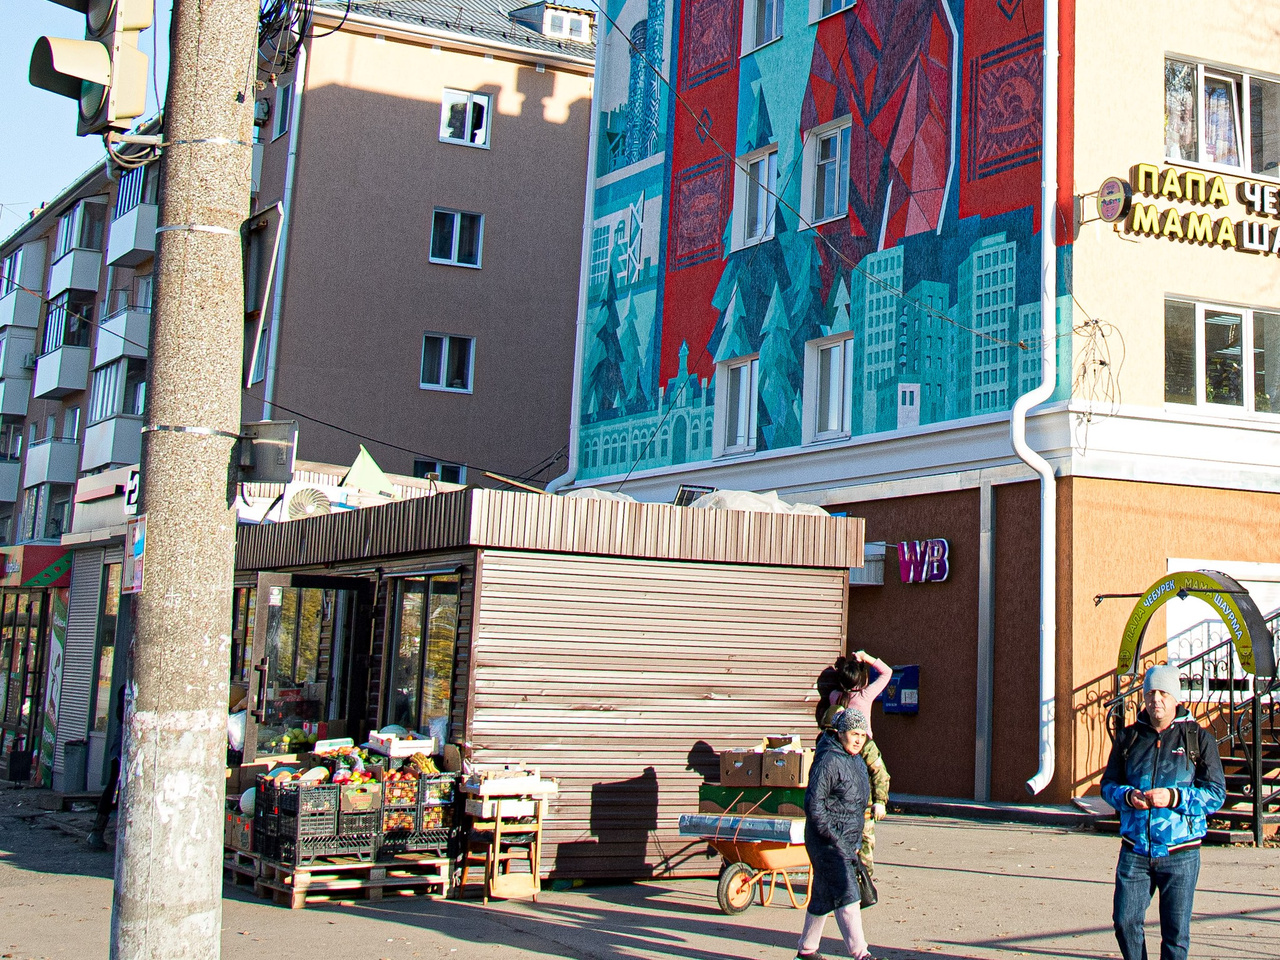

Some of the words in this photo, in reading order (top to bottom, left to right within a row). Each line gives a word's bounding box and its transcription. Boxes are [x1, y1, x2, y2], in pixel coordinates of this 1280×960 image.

[1136, 162, 1230, 207] ПАПА
[1132, 203, 1237, 247] МАМА
[898, 538, 950, 583] WB
[1125, 607, 1145, 642] ПАПА
[1143, 579, 1176, 607] ЧЕБУРЕК
[1213, 592, 1243, 640] ШАУРМА
